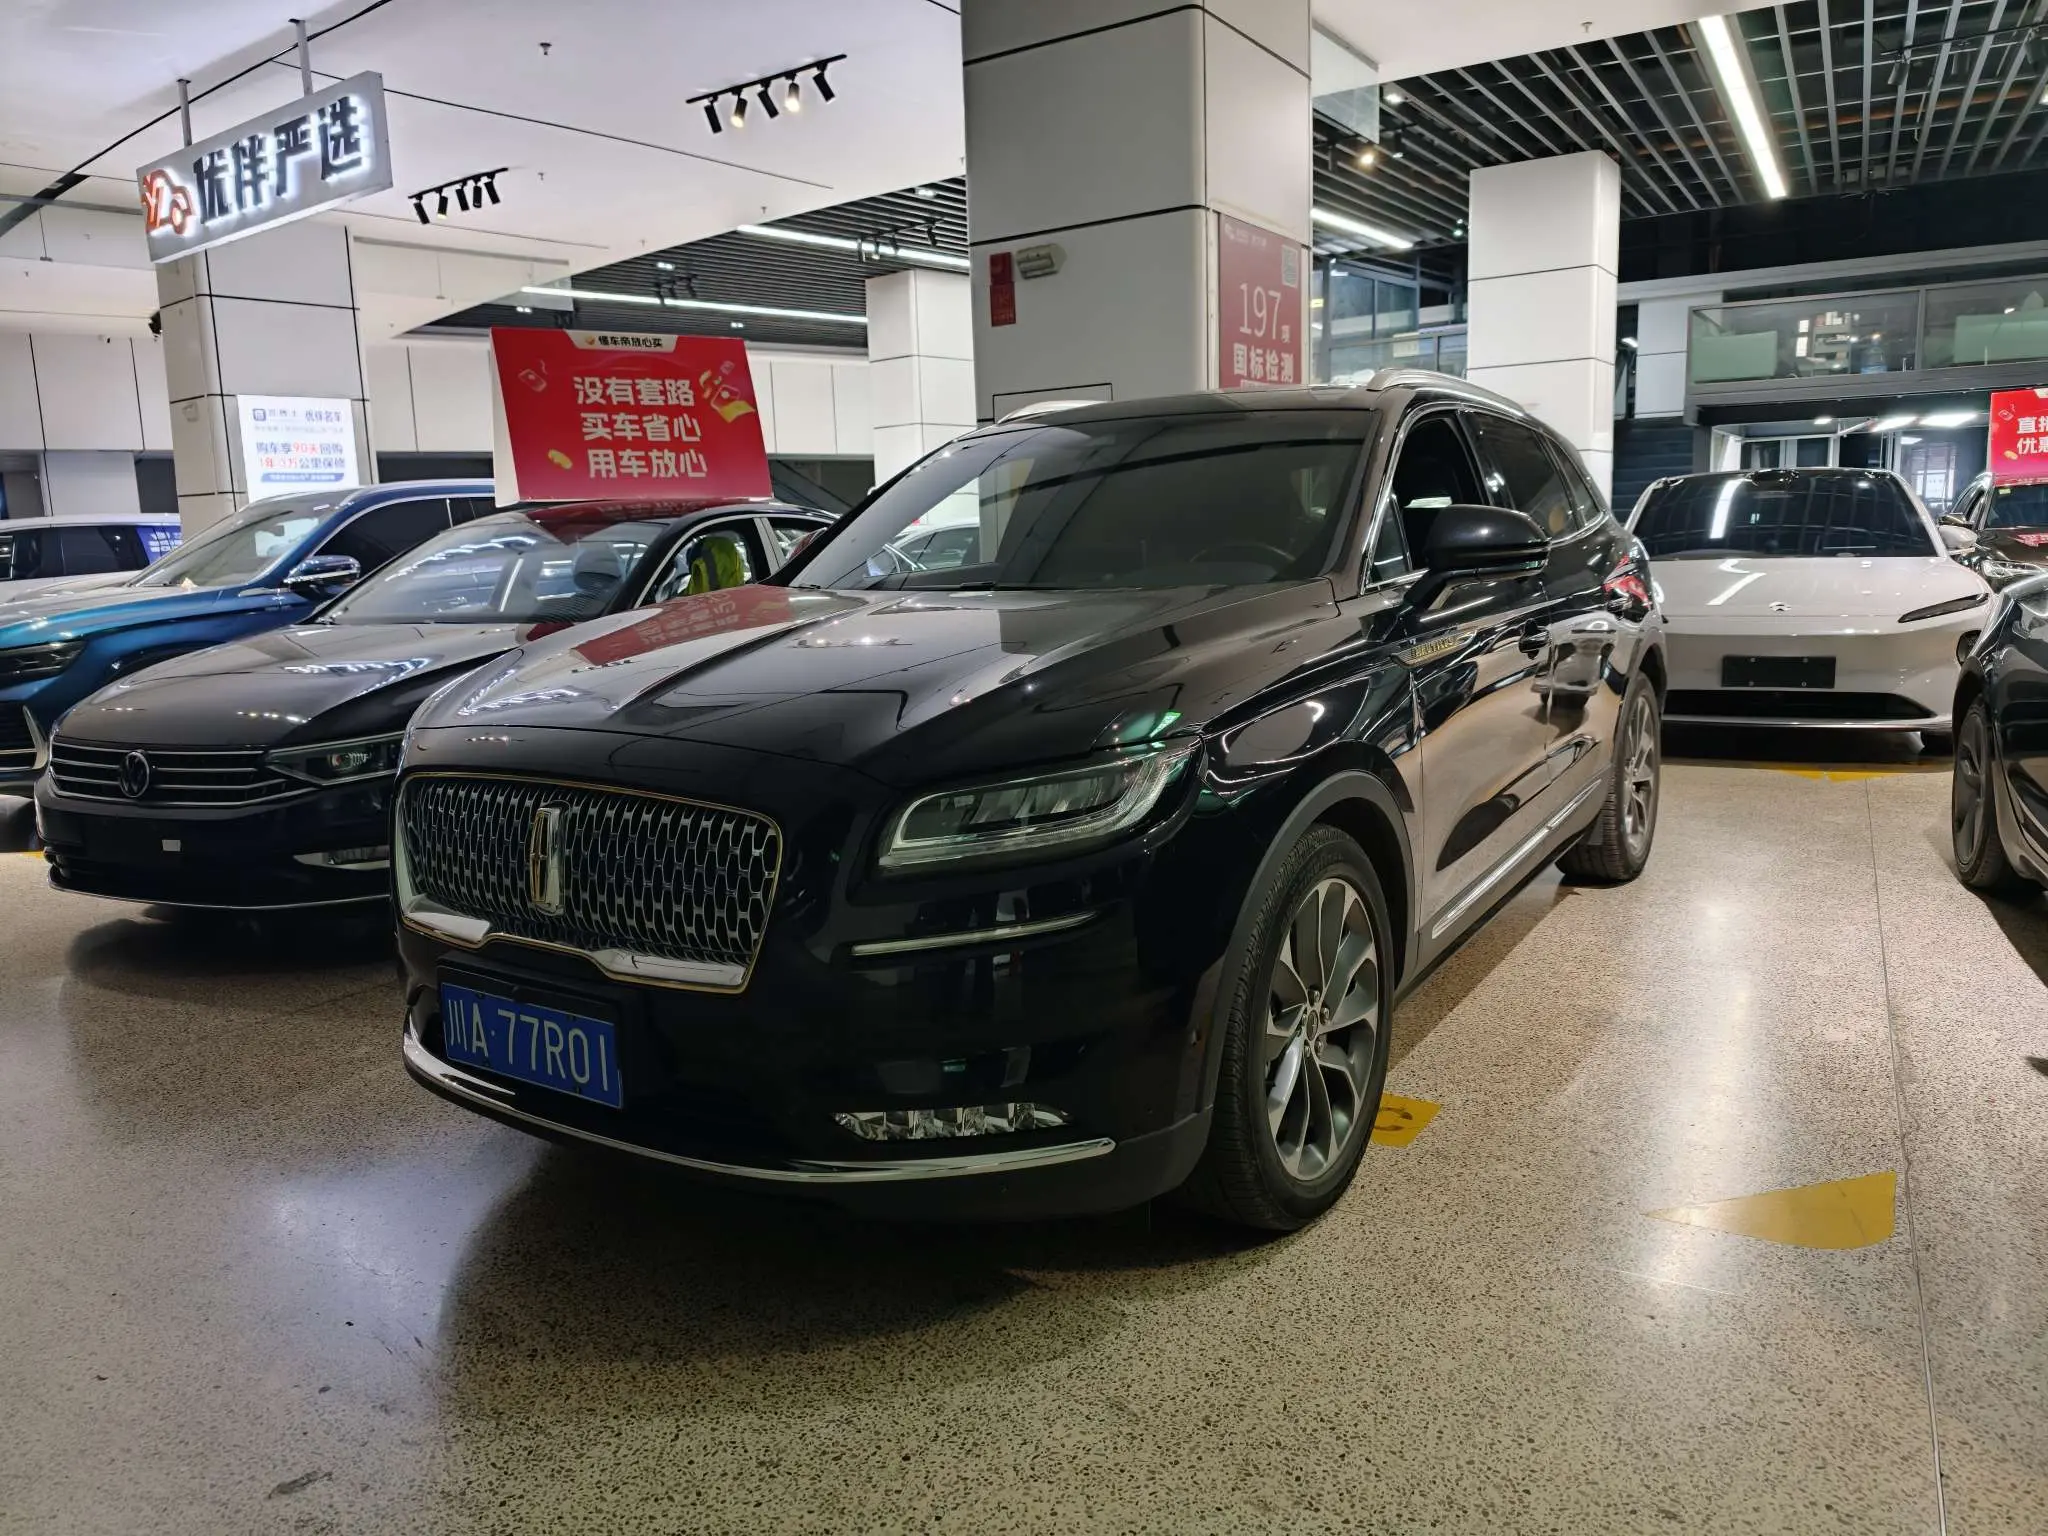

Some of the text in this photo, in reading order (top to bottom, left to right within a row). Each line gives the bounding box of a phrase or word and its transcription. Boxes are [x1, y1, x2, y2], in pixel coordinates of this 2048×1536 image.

[598, 335, 663, 348] 懂车帝放心买
[1233, 342, 1294, 384] 国标检测
[573, 376, 695, 407] 没有套路
[580, 412, 702, 442] 买车省心
[587, 449, 708, 478] 用车放心
